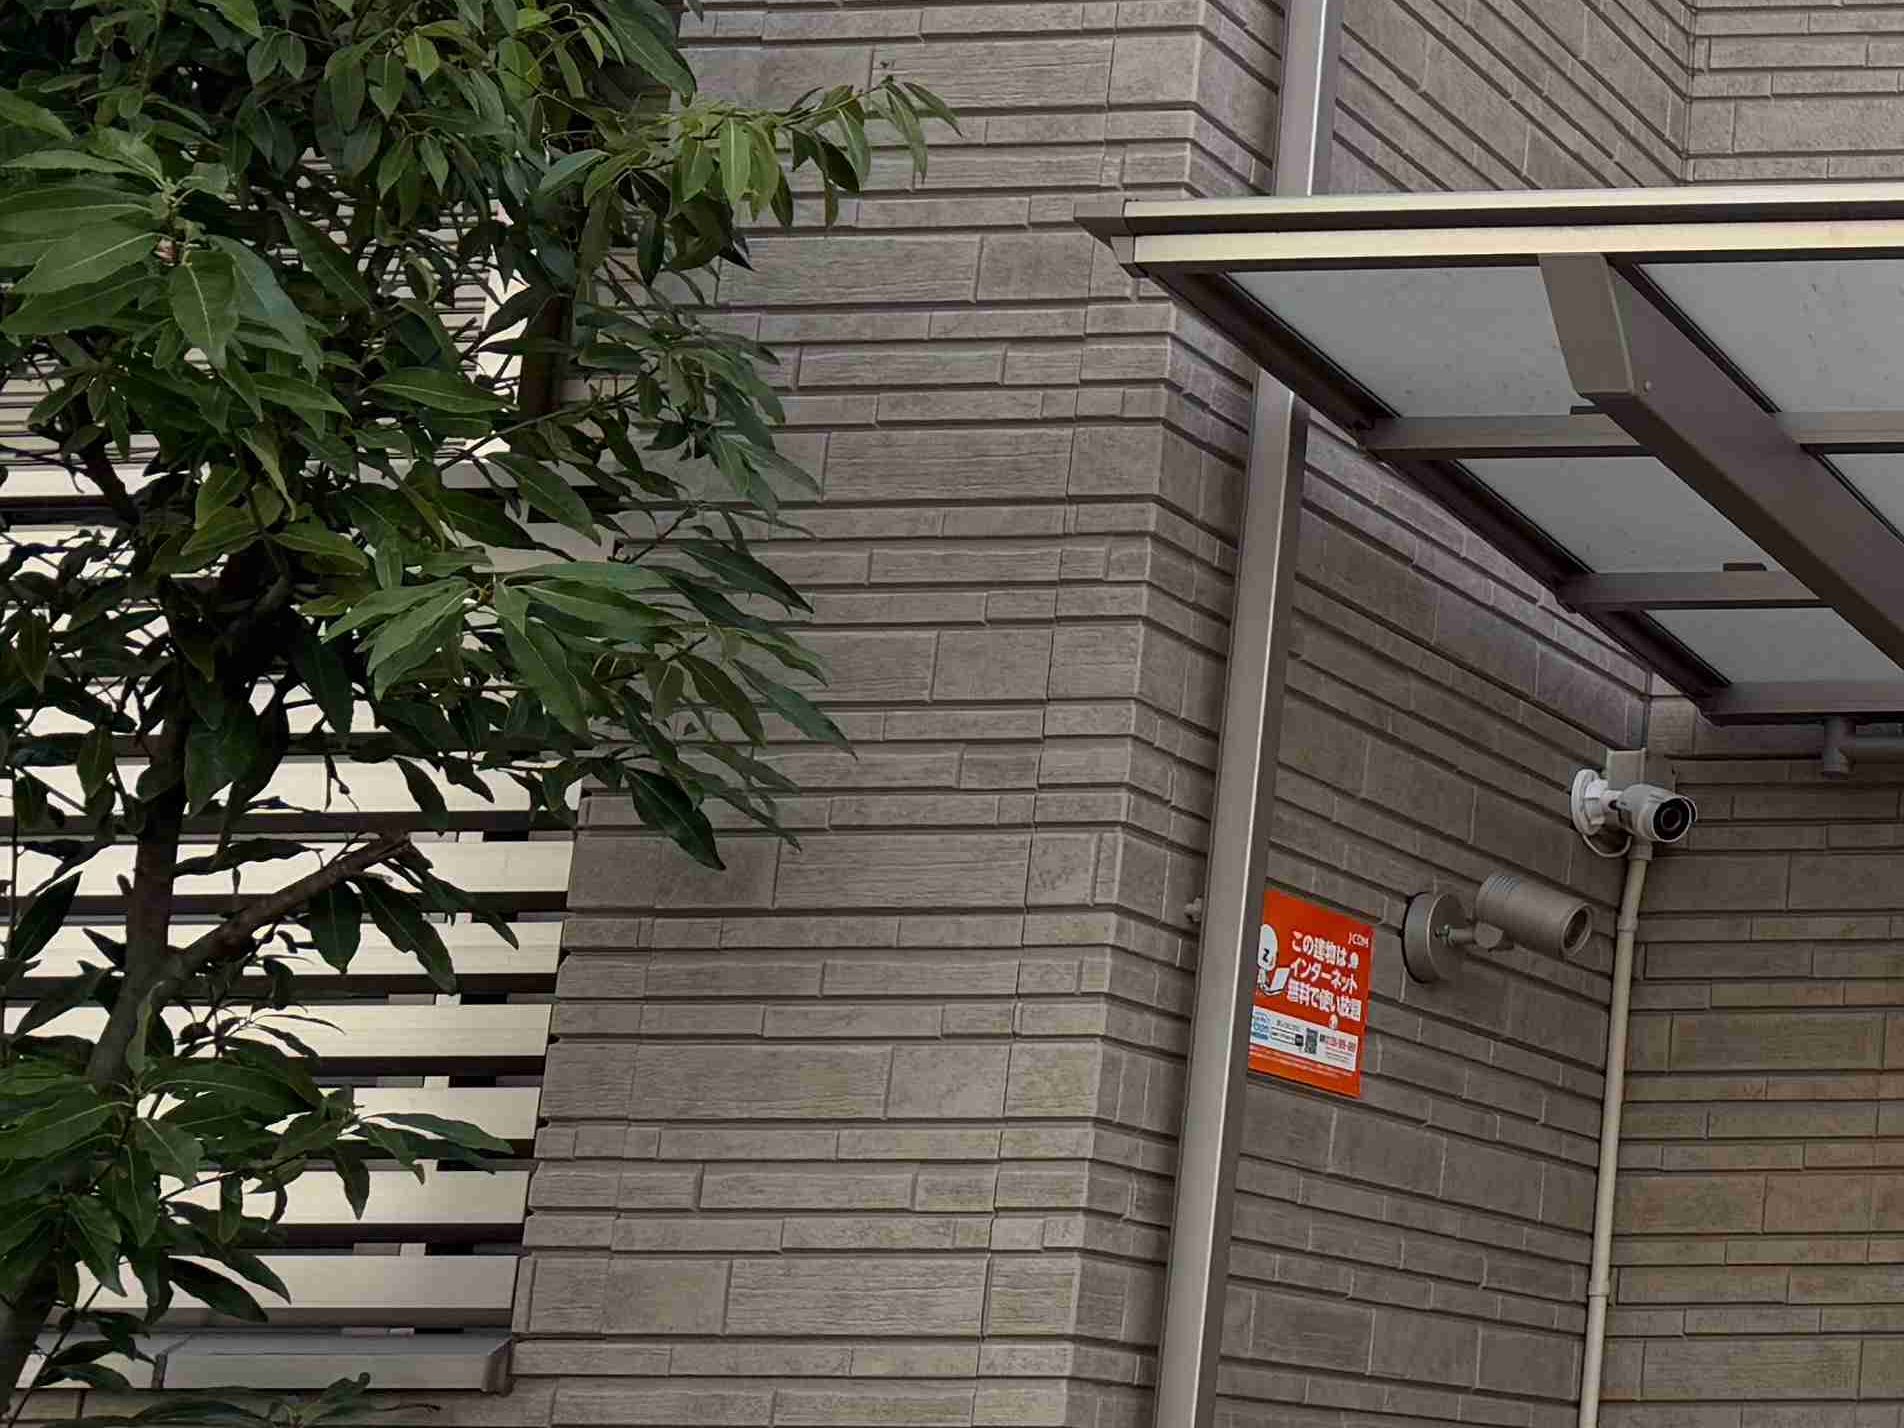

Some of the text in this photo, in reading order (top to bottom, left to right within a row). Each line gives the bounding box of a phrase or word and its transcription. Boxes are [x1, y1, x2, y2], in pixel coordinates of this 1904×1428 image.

[1290, 957, 1359, 995] インターネット
